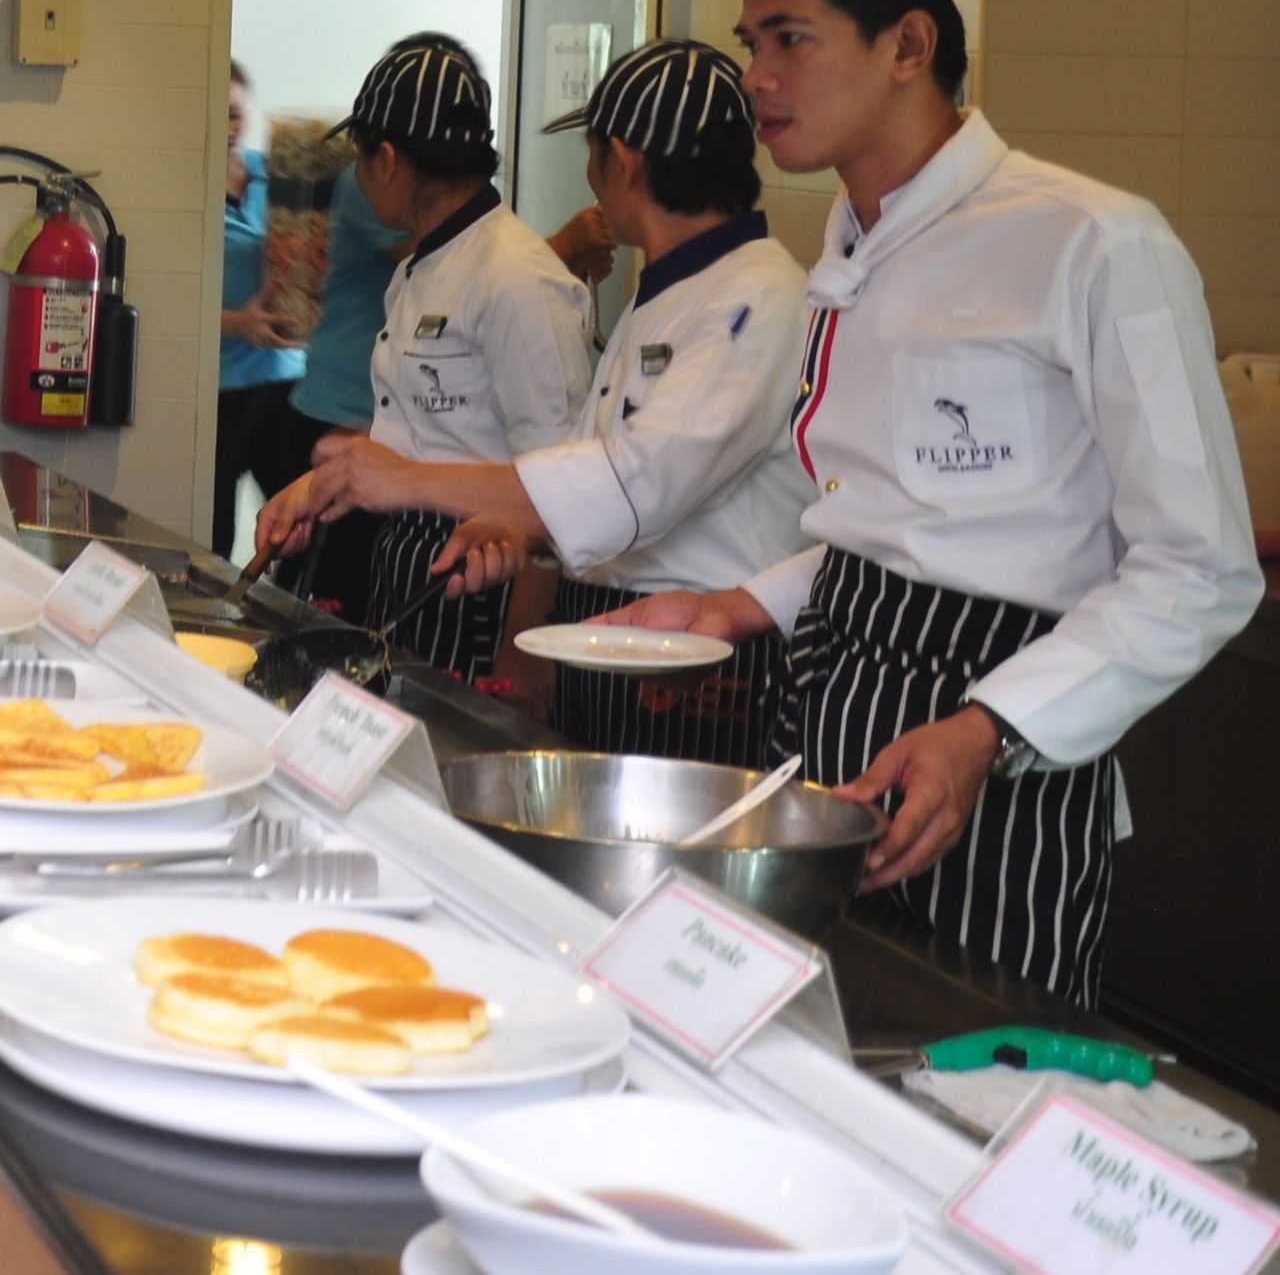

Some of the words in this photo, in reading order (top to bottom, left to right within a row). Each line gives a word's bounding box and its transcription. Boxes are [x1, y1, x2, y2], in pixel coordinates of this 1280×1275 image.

[914, 444, 1014, 465] FLIPPER
[1060, 1129, 1141, 1194] Maple
[1140, 1173, 1221, 1247] Syrup
